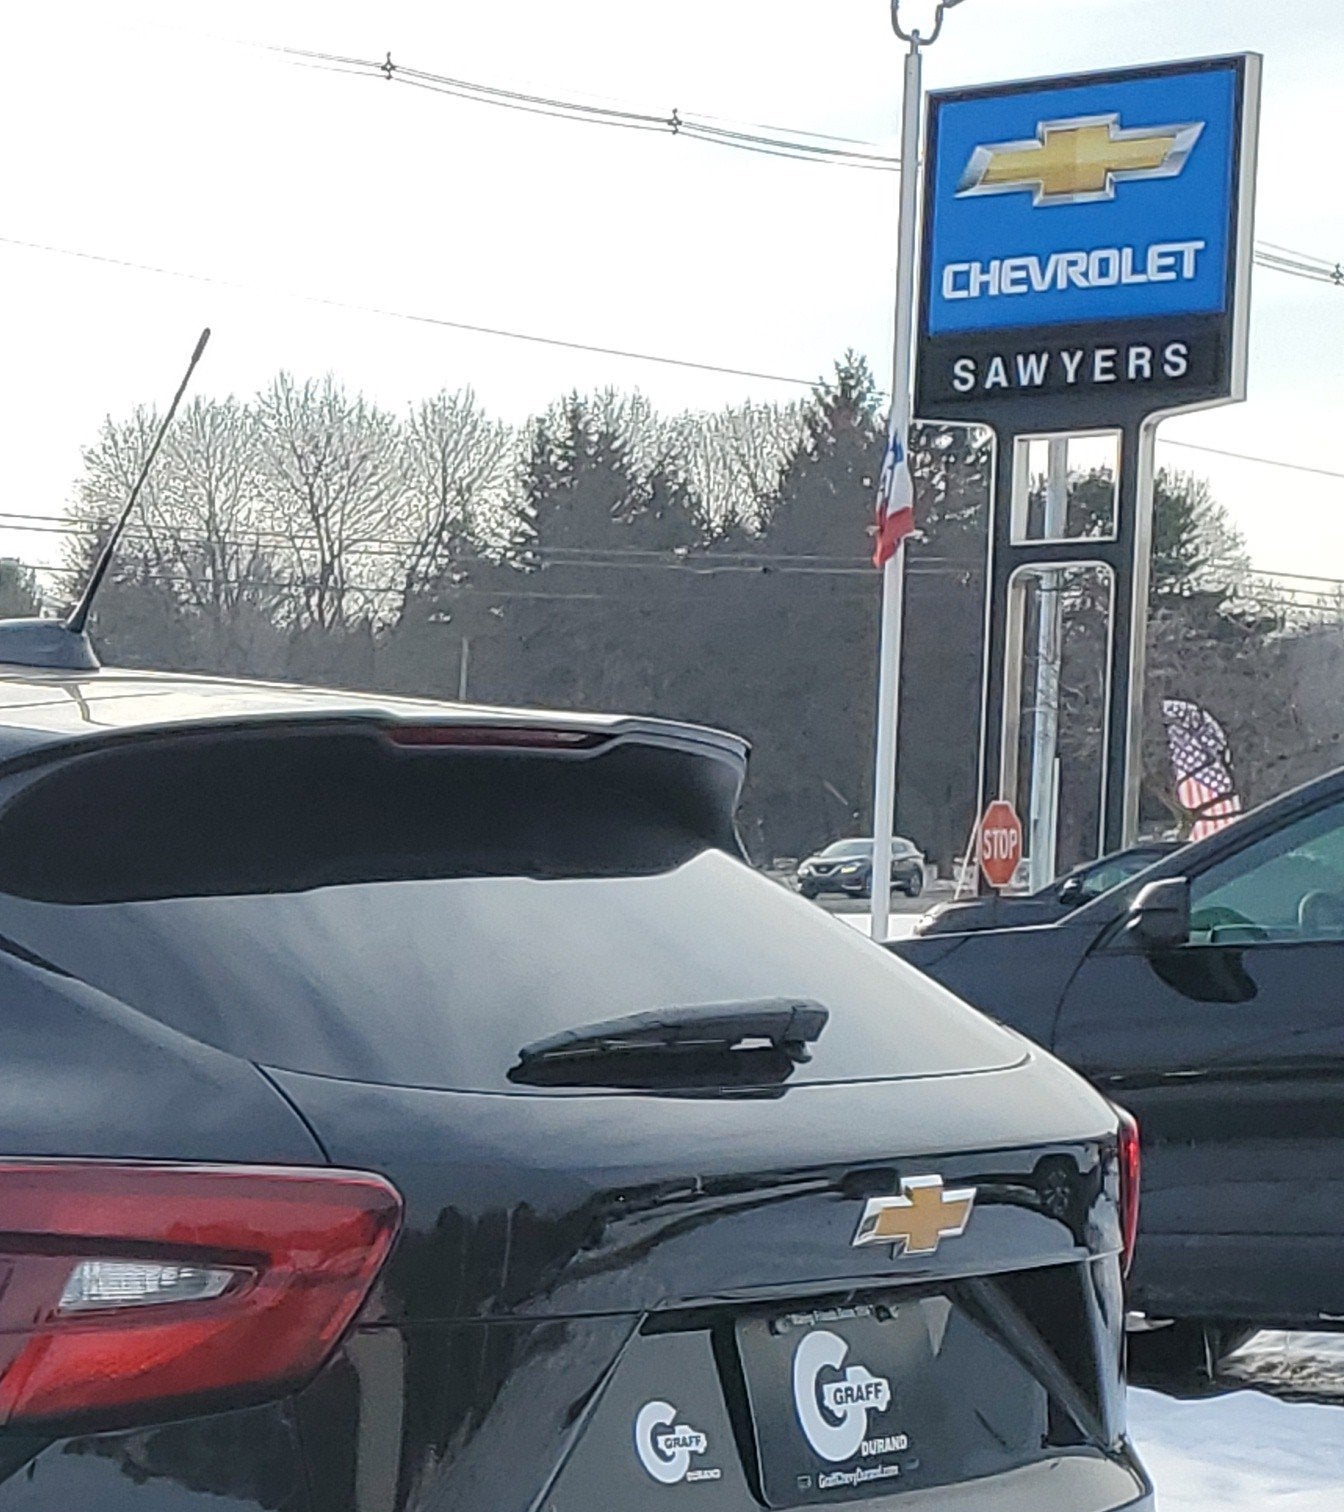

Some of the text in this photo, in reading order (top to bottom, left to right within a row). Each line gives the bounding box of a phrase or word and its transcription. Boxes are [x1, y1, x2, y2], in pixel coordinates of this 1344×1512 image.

[942, 241, 1205, 300] CHEVROLET
[953, 343, 1189, 392] SAWYERS
[983, 829, 1017, 859] STOP
[833, 1382, 883, 1405] GRAFF
[664, 1436, 701, 1449] GRAFF
[861, 1434, 908, 1457] DURAND
